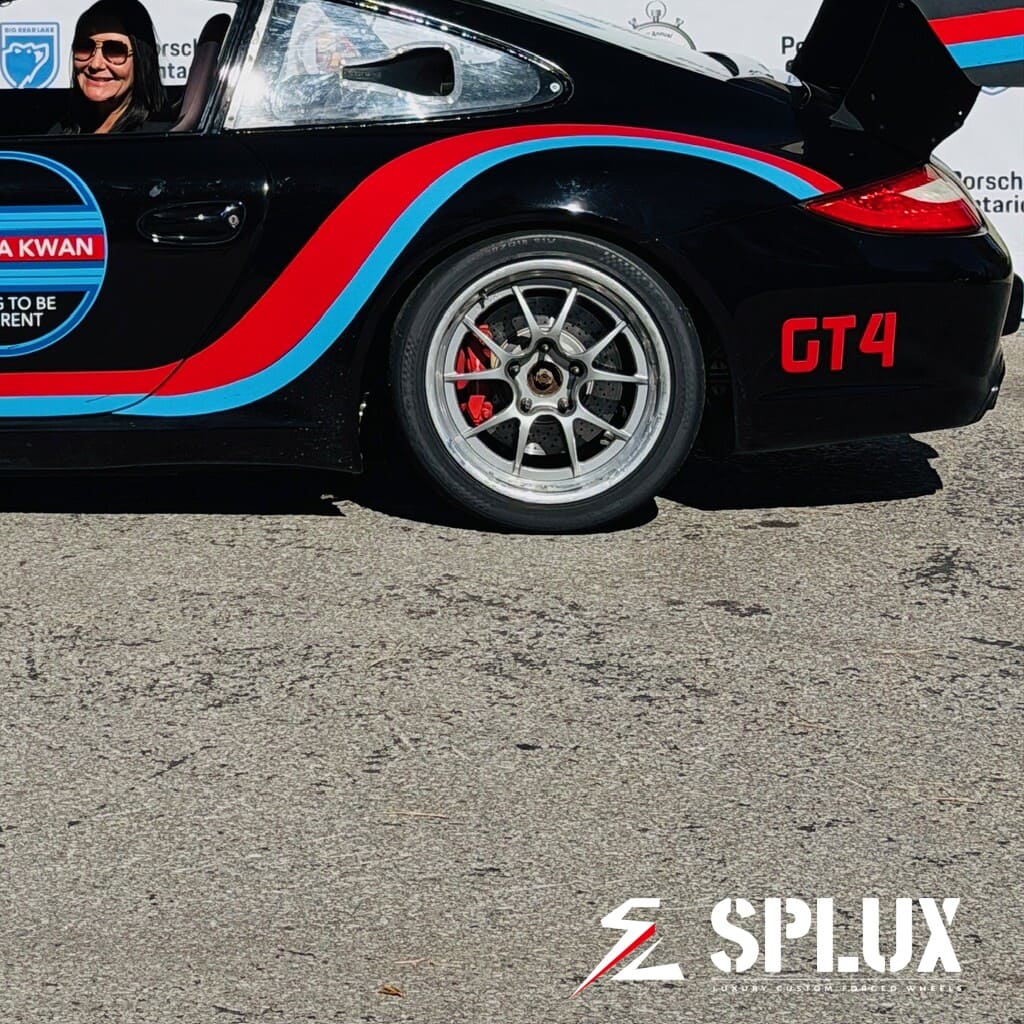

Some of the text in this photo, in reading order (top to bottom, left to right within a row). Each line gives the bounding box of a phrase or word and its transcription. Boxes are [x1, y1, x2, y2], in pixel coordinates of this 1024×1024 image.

[18, 238, 93, 258] KWAN
[8, 296, 32, 311] TO
[36, 296, 57, 310] BE
[781, 312, 897, 373] GT4
